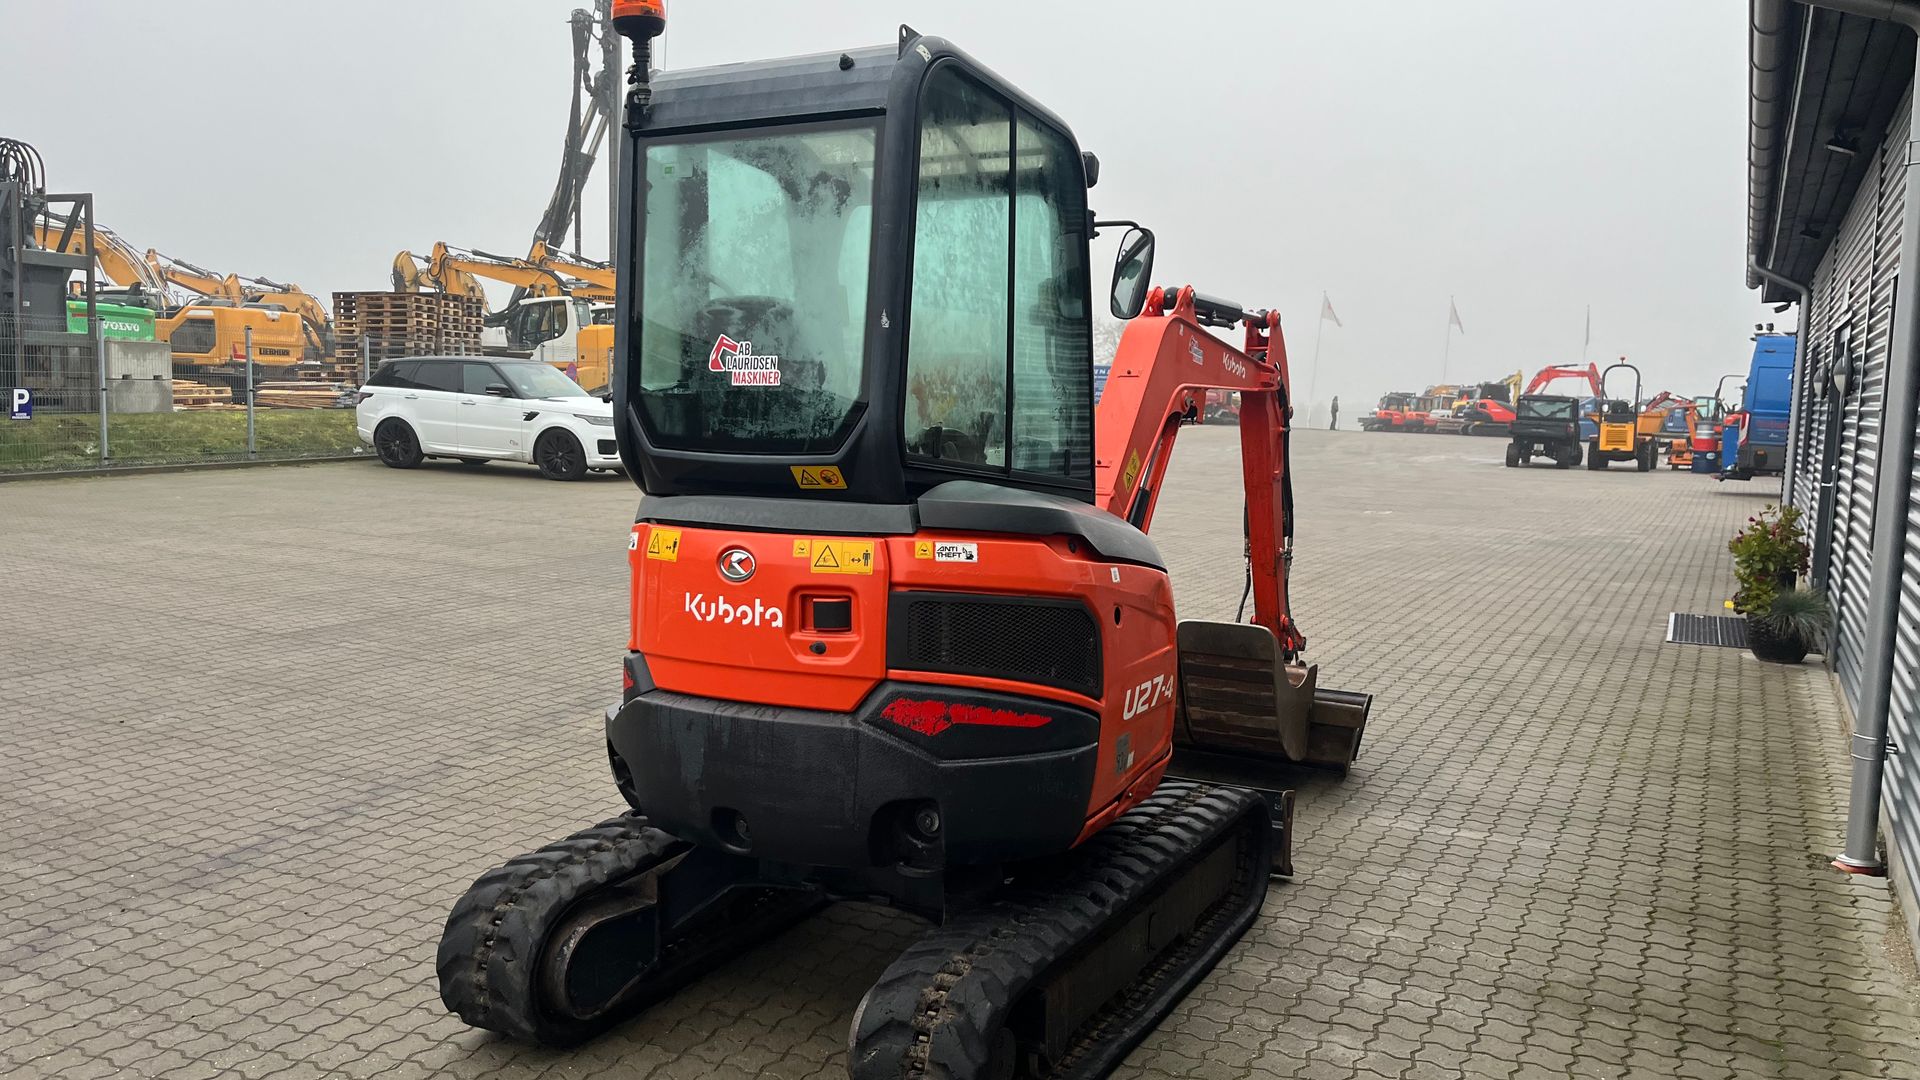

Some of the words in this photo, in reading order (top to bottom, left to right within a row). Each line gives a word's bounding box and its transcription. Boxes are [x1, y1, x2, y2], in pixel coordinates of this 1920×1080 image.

[102, 320, 140, 332] VOLVO
[738, 342, 751, 356] AB
[726, 356, 777, 371] LAURIDSEN
[1222, 351, 1246, 379] Kubota
[732, 371, 780, 385] MASKINER
[13, 388, 30, 412] P
[685, 592, 783, 628] Kubota
[1123, 674, 1174, 720] U27-4
